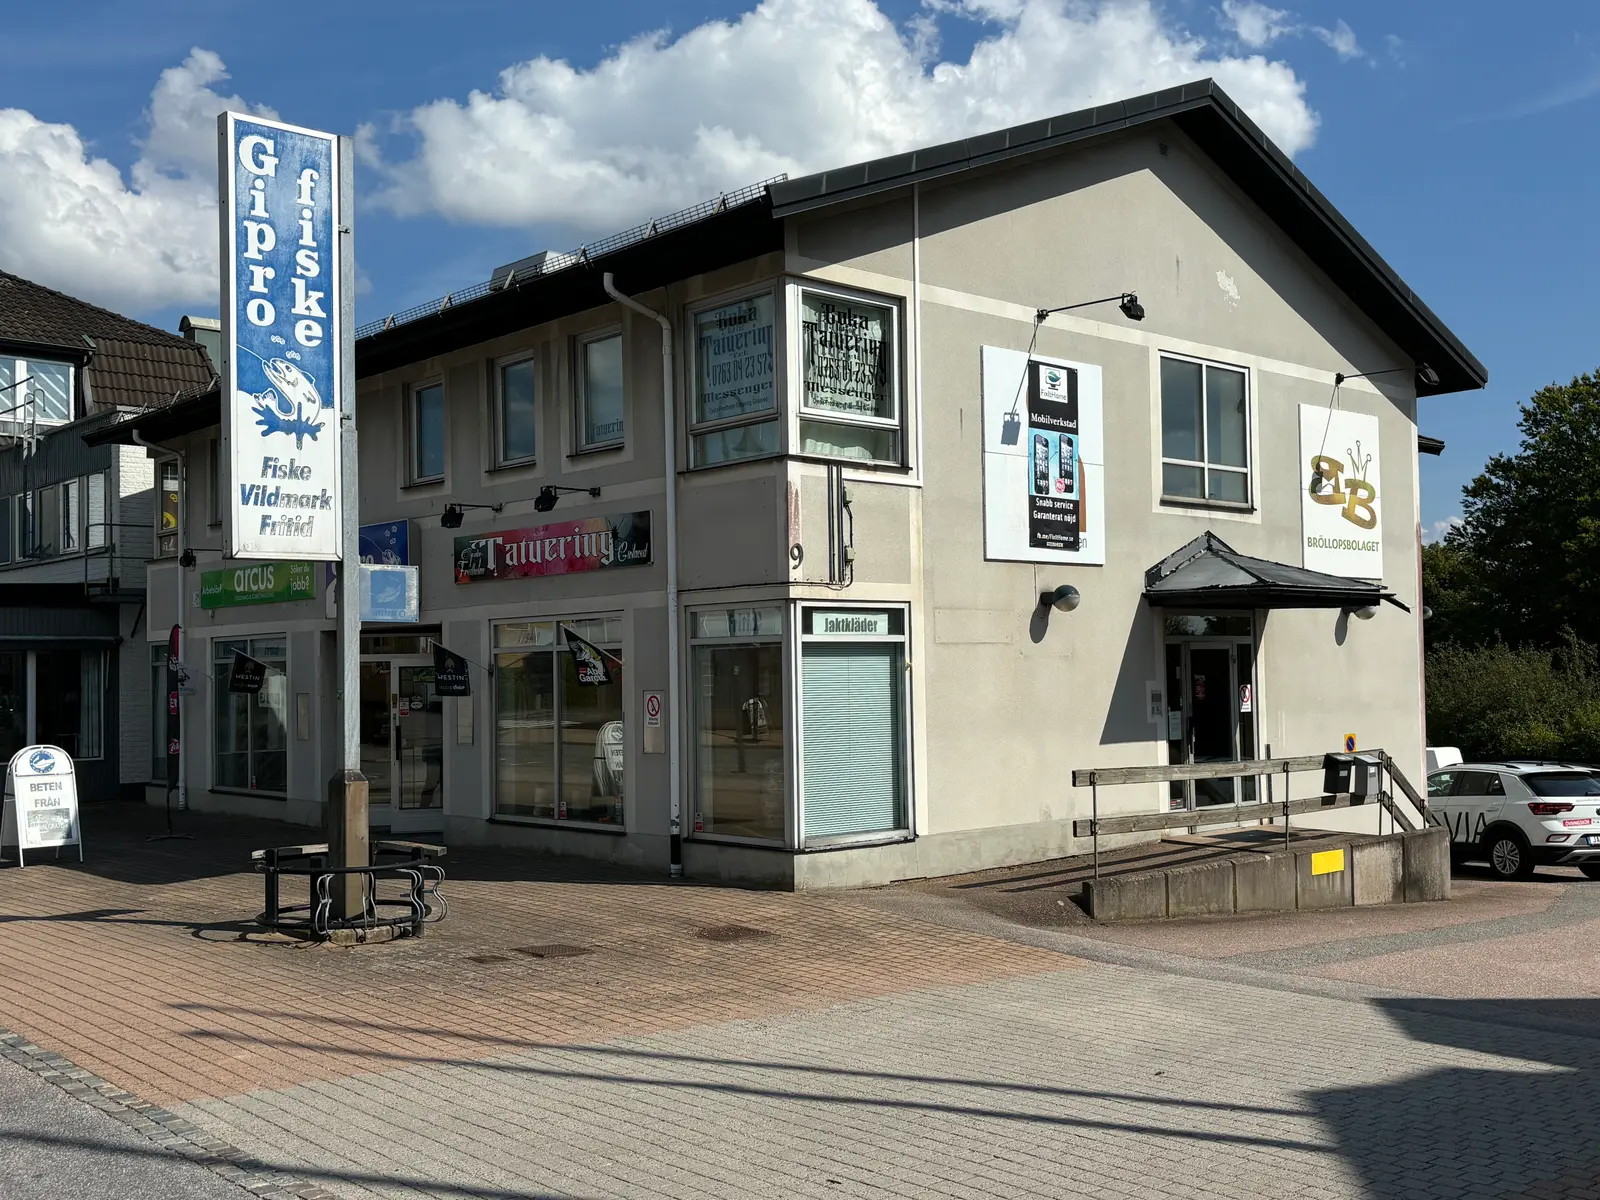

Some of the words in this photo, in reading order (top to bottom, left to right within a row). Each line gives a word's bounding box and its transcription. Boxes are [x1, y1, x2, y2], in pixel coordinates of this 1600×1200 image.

[238, 135, 279, 327] Gipro
[291, 168, 326, 347] fiske
[820, 302, 869, 331] Boka
[1031, 412, 1077, 429] Mobilverkstad
[260, 456, 312, 481] Fiske
[240, 484, 333, 510] Vildmark
[1036, 498, 1053, 508] Snabb
[1054, 501, 1074, 510] service
[259, 514, 315, 537] Fritid
[1033, 510, 1063, 522] Garanterat
[1063, 514, 1076, 524] nöjd
[469, 526, 614, 577] Tatuering
[1307, 535, 1380, 552] BRÖLLOPSBOLAGET
[790, 543, 803, 570] 9
[234, 565, 274, 593] arcus
[290, 576, 310, 595] jobb?
[824, 617, 878, 632] Jaktkläder
[235, 673, 261, 681] WESTIN
[30, 781, 62, 792] BETEN
[34, 796, 61, 808] FRÅN
